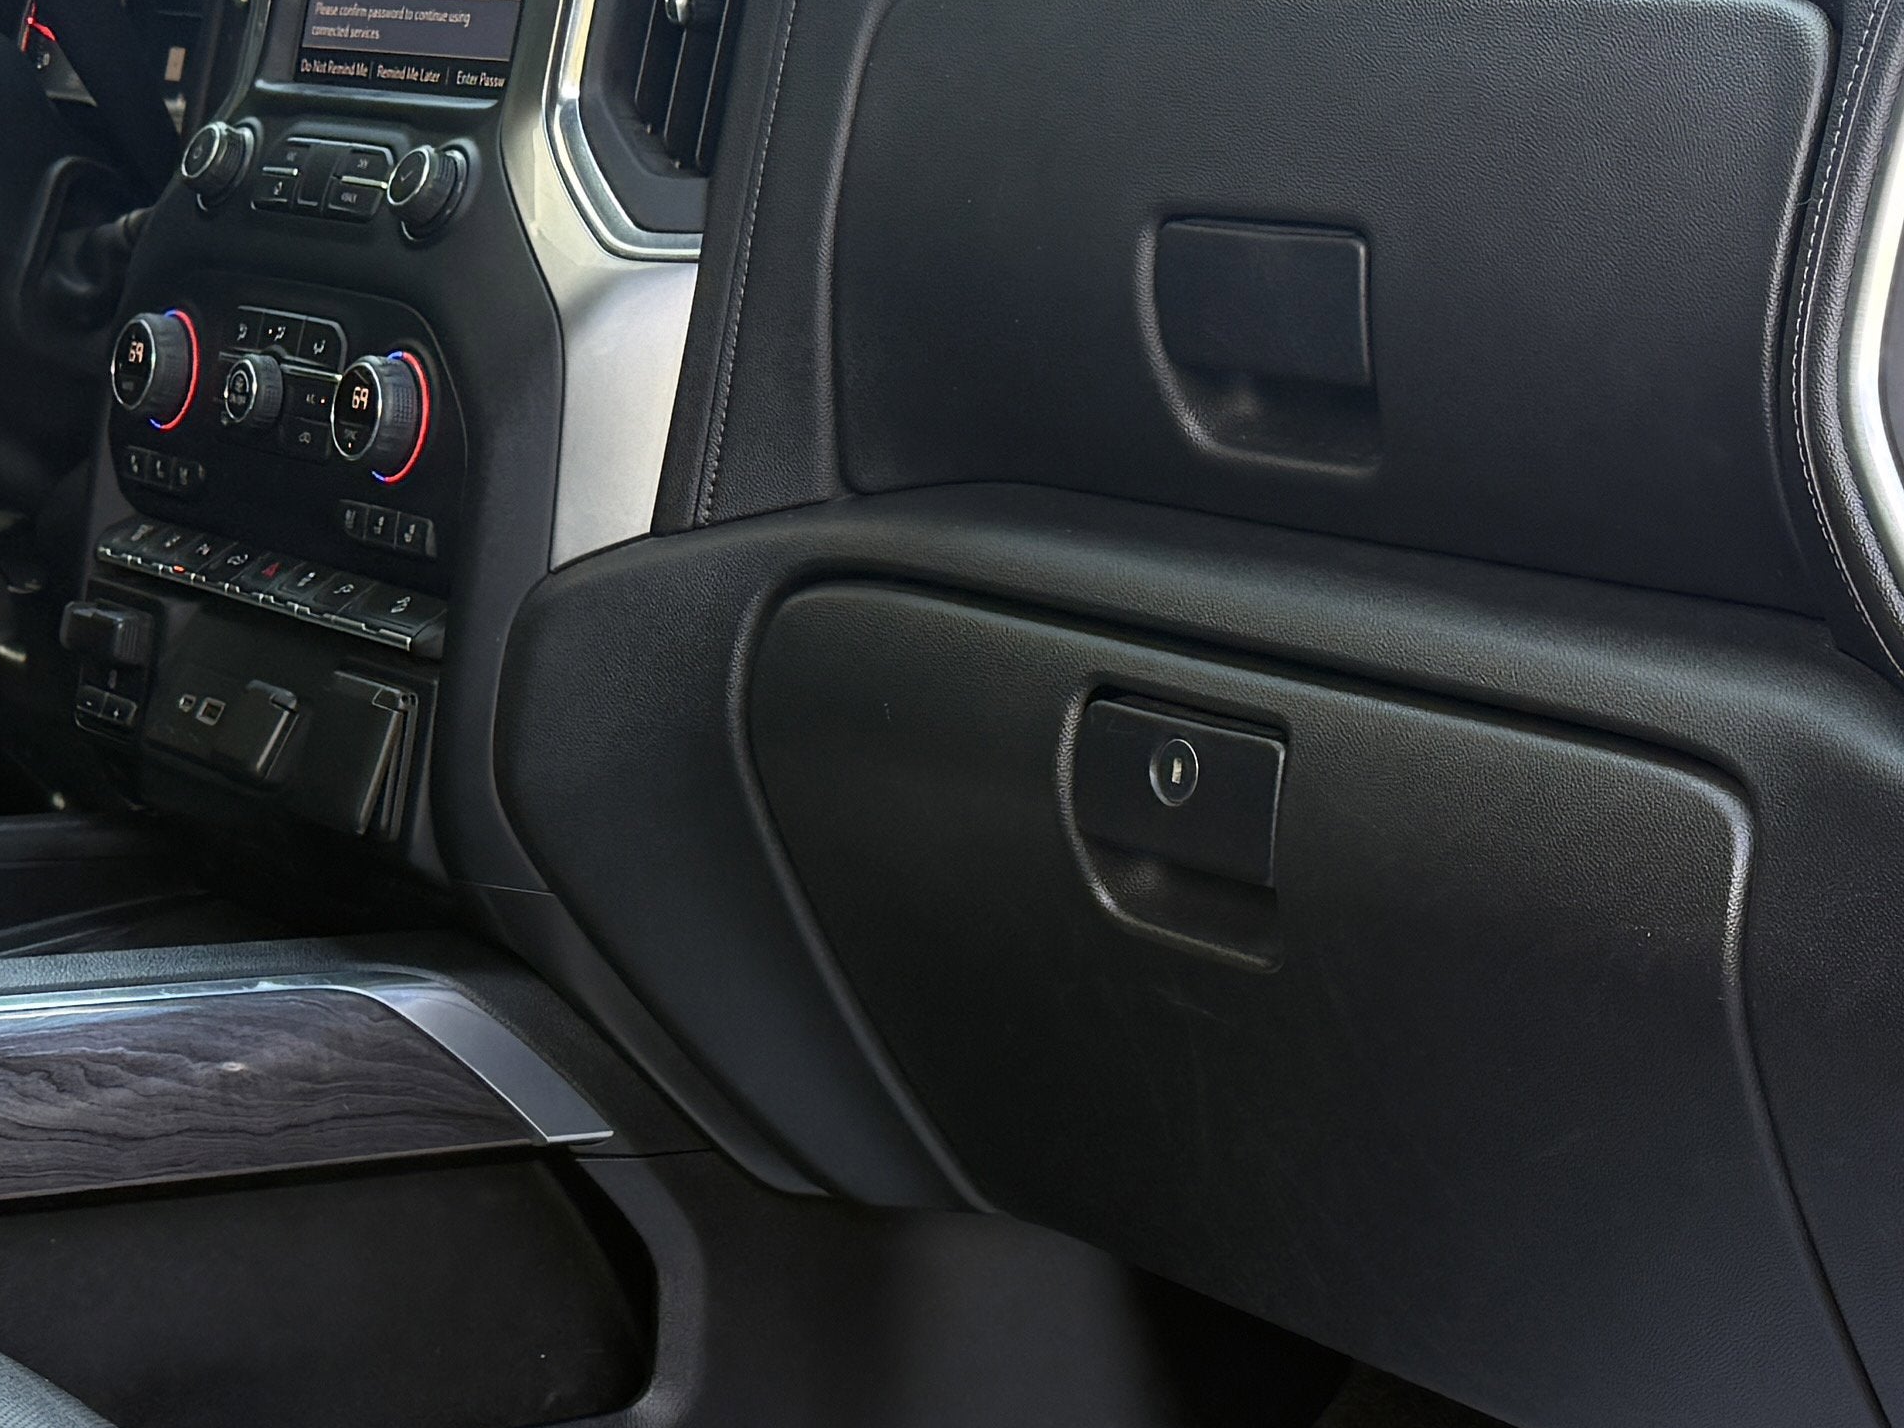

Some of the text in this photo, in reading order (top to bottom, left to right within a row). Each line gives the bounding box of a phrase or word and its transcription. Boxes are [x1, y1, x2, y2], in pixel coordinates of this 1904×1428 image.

[315, 1, 471, 28] Please confirm password to continue using
[311, 25, 380, 39] connected services
[301, 59, 368, 77] Do Not Remind Me
[377, 65, 441, 83] Remind Me Later
[456, 71, 478, 86] Enter
[128, 341, 144, 363] 69
[351, 386, 369, 410] 69
